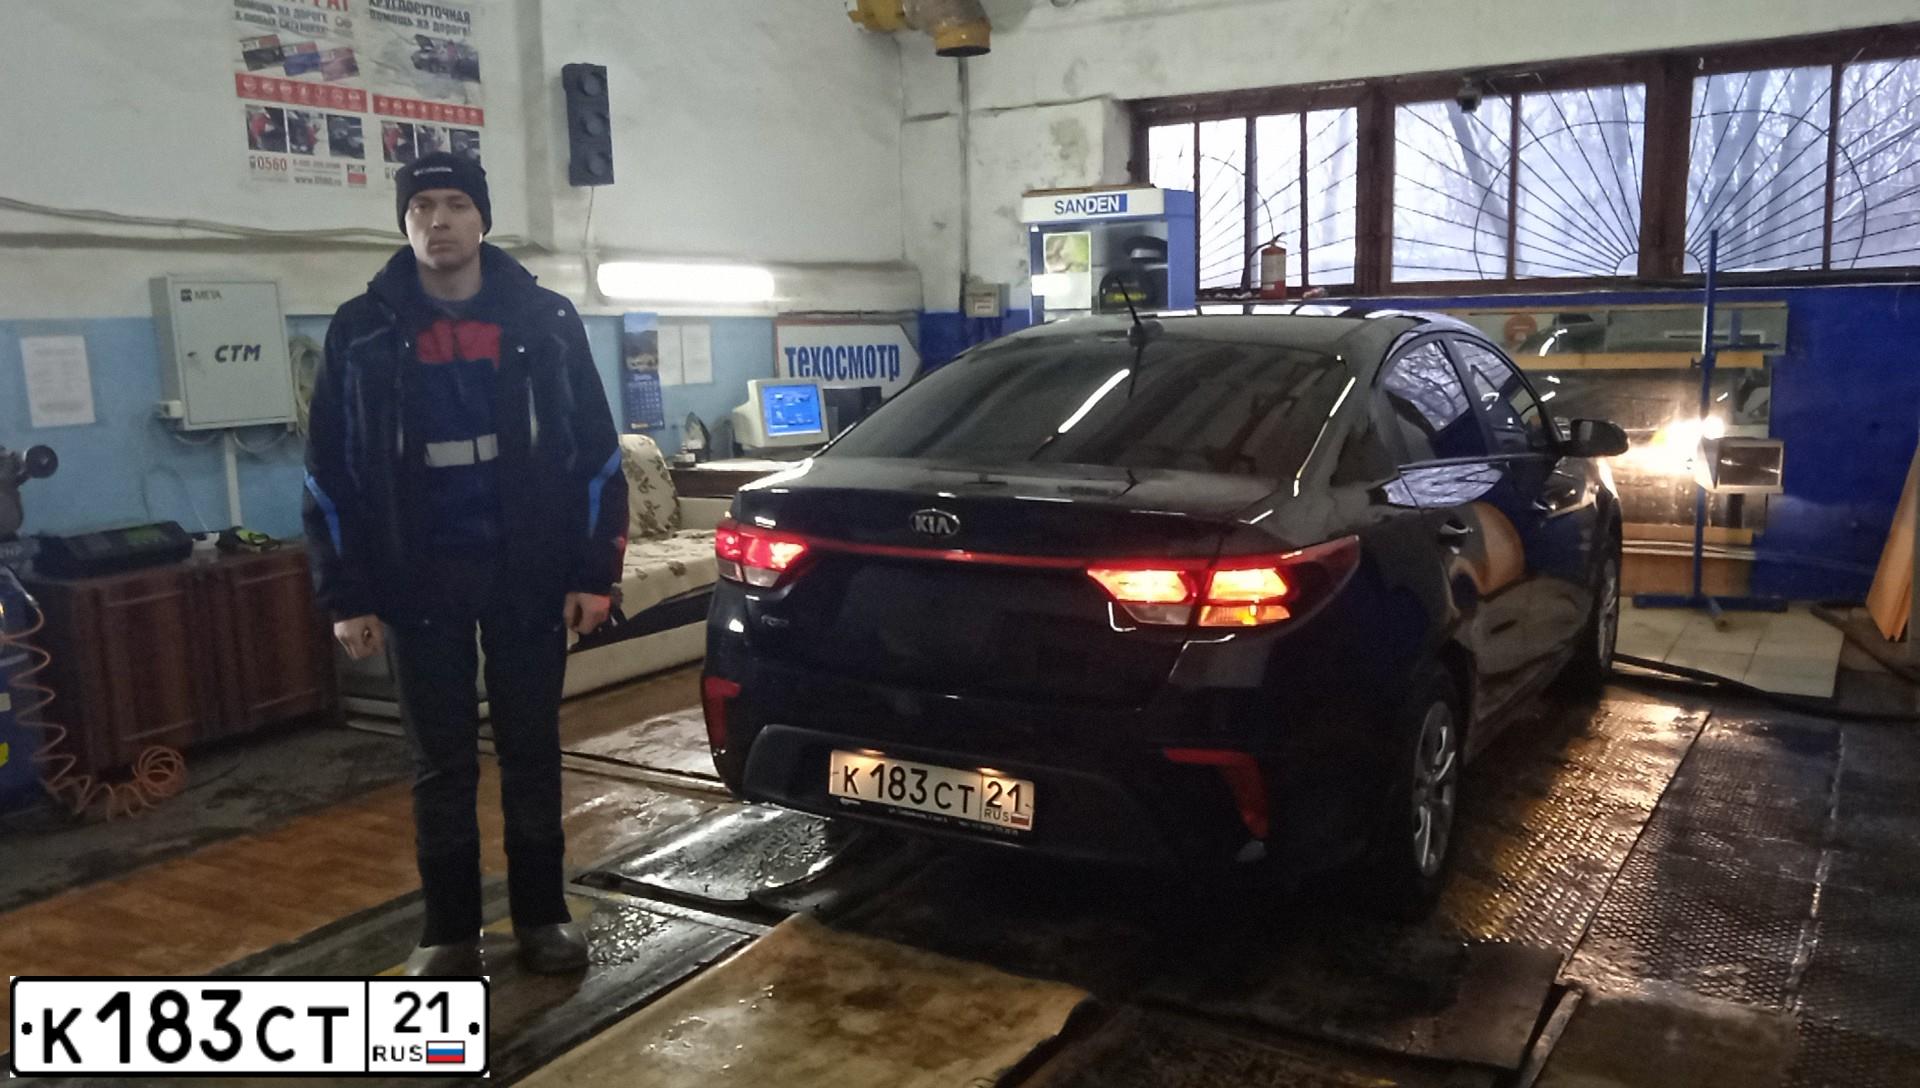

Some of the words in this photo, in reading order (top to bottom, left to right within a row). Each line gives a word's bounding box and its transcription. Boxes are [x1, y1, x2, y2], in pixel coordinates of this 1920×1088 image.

[257, 156, 288, 172] 0560
[1054, 196, 1119, 214] SANDEN
[784, 344, 900, 382] техосмотр
[914, 514, 950, 534] KIA
[986, 780, 1021, 812] 21
[984, 808, 1009, 822] RUS
